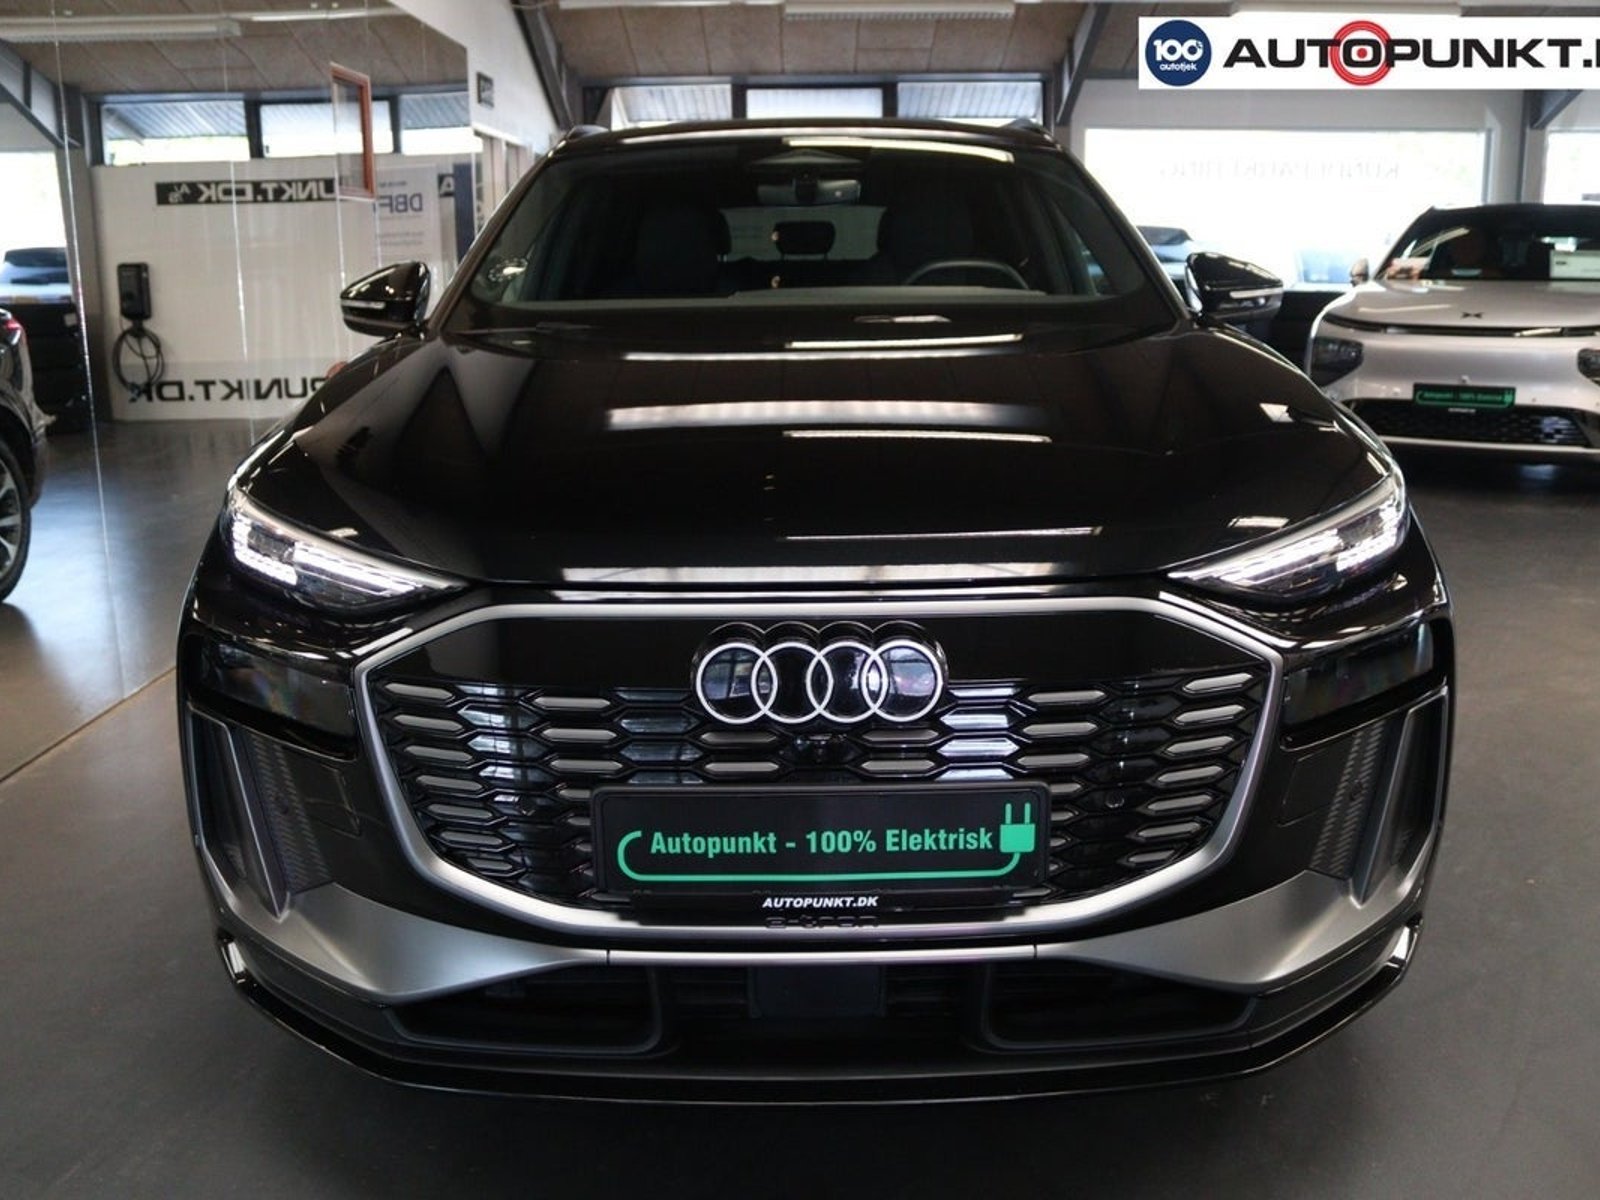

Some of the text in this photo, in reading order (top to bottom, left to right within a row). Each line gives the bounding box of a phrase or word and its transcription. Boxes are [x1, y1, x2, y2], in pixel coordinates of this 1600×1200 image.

[650, 831, 777, 859] Autopunkt
[805, 830, 877, 853] 100%
[886, 827, 993, 852] Elektrisk
[762, 896, 878, 908] AUTOPUNKT.DK
